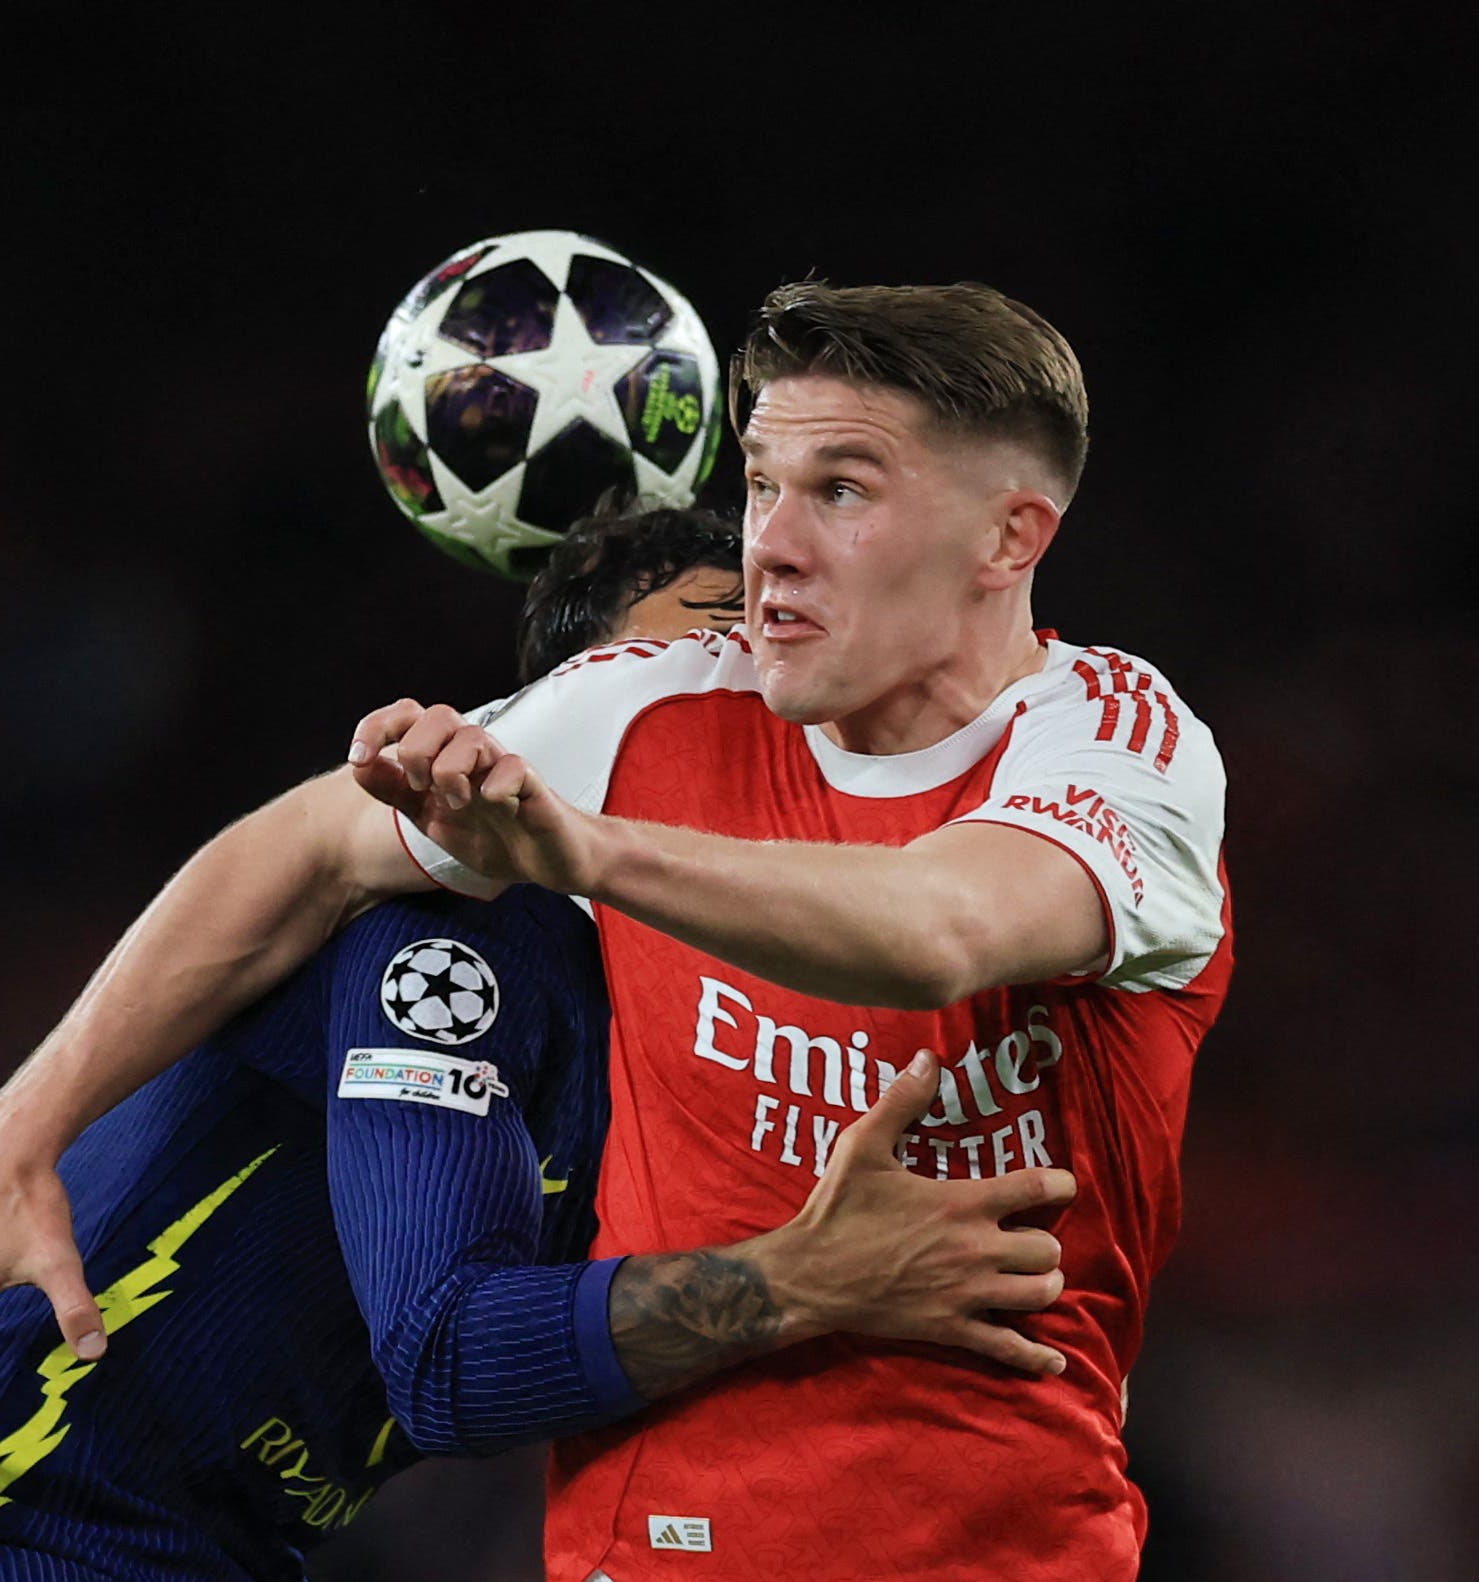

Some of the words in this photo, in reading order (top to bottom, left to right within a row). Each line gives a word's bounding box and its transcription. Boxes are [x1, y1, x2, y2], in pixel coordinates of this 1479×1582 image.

[346, 1067, 445, 1087] FOUNDATION
[448, 1068, 487, 1100] 10
[750, 1094, 840, 1178] FLY
[896, 1109, 1054, 1181] ETTER
